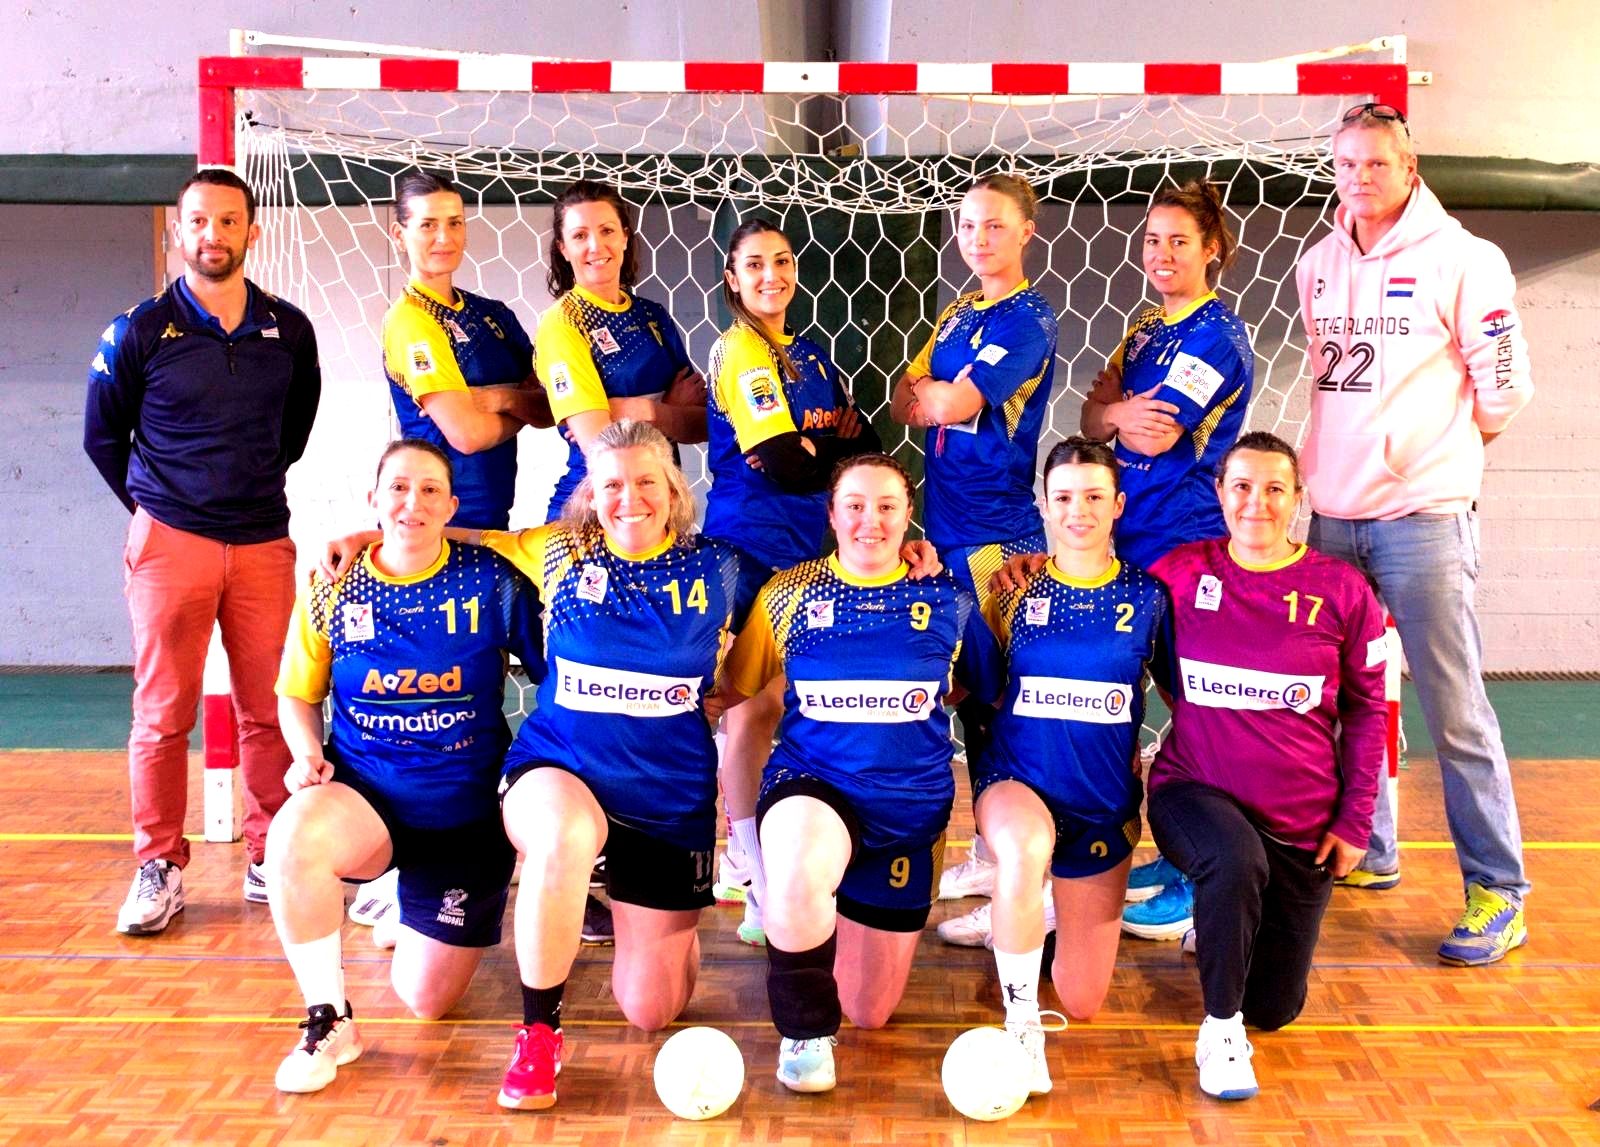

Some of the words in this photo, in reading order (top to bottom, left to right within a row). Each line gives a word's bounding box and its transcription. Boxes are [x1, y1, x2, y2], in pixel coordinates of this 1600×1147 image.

[969, 325, 985, 350] 4
[1313, 316, 1410, 336] ETHERLANDS
[1316, 340, 1375, 392] 22
[662, 578, 709, 615] 14
[1283, 590, 1324, 626] 17
[439, 596, 479, 634] 11
[910, 601, 932, 631] 9
[1115, 602, 1135, 633] 2
[626, 702, 660, 710] ROYAN
[867, 709, 899, 717] ROYAN
[889, 856, 910, 888] 9
